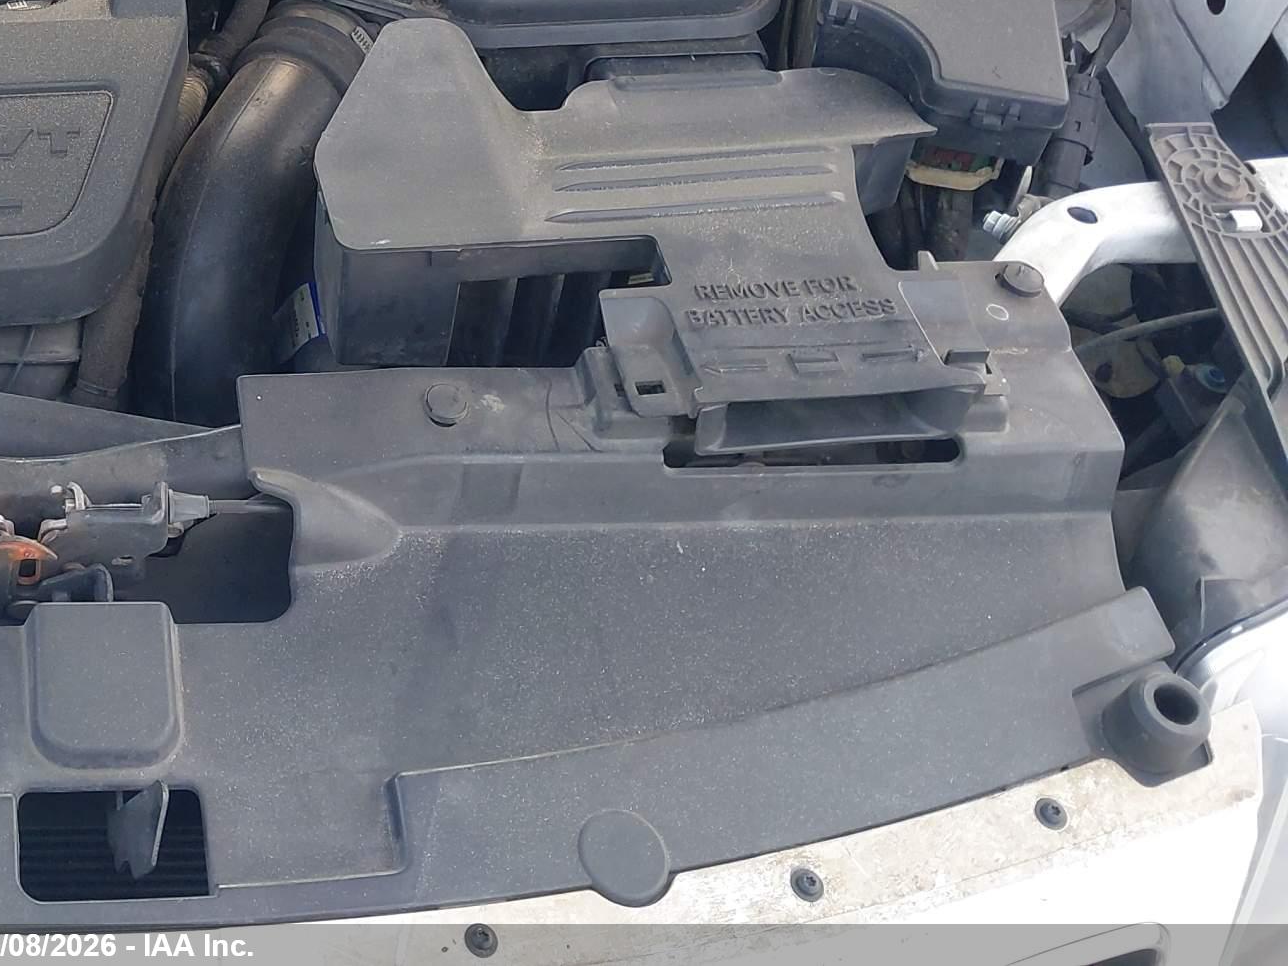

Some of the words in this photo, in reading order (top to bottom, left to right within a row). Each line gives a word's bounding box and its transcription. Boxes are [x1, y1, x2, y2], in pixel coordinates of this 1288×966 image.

[694, 280, 800, 301] REMOVE
[803, 275, 857, 294] FOR
[686, 306, 789, 327] BATTERY
[799, 297, 897, 322] ACCESS
